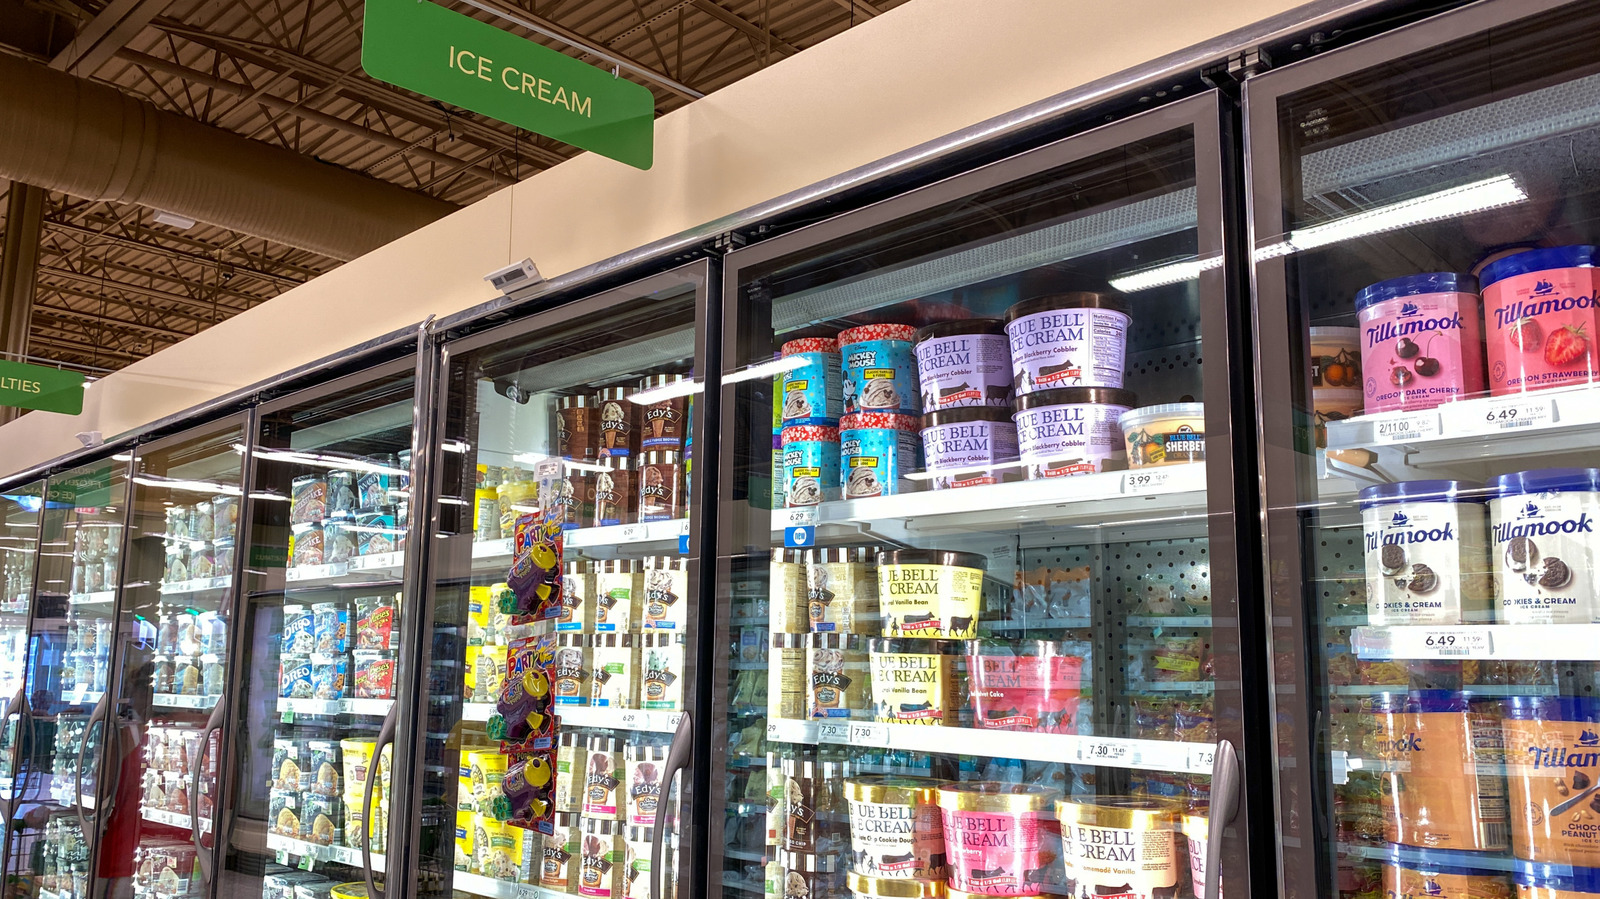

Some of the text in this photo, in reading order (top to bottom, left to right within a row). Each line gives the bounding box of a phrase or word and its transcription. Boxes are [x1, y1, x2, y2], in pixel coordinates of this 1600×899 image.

[449, 46, 592, 118] ICE CREAM
[1494, 289, 1600, 330] Tillamook
[1010, 313, 1084, 340] BLUE BELL
[1366, 311, 1463, 348] Tillamook
[1026, 328, 1084, 347] CREAM
[934, 340, 971, 356] BELL
[1053, 345, 1078, 354] Cobbler
[848, 351, 877, 362] MICKEY
[848, 358, 876, 369] MOUSE
[924, 353, 970, 372] CREAM
[1406, 388, 1427, 396] DARK
[647, 406, 673, 420] Edy's
[1042, 408, 1085, 424] BELL
[601, 418, 624, 431] Edy's
[1029, 422, 1084, 440] CREAM
[949, 425, 988, 440] BELL
[936, 438, 988, 454] CREAM
[1165, 441, 1205, 452] SHERBET
[1492, 512, 1593, 547] Tillamook
[515, 524, 548, 555] PARTY
[902, 568, 939, 582] BELL
[889, 582, 939, 595] CREAM
[1503, 597, 1576, 606] COKIES & CREAM
[284, 617, 311, 640] OREO
[1425, 635, 1456, 646] 6.49
[508, 650, 538, 680] PARTY
[898, 656, 937, 669] BELL
[984, 660, 1020, 673] BELL
[282, 666, 310, 690] OREO
[556, 666, 581, 678] Edy's
[813, 671, 841, 685] Edy's
[989, 690, 1004, 698] Cake
[1089, 745, 1108, 755] 7.30
[635, 782, 662, 795] Edy's
[878, 806, 917, 820] BELL
[865, 819, 917, 834] CREAM
[966, 817, 1008, 832] BELL
[1090, 829, 1136, 846] BELL
[1561, 829, 1596, 839] PEANUT
[1083, 865, 1136, 875] omemade Vanilla
